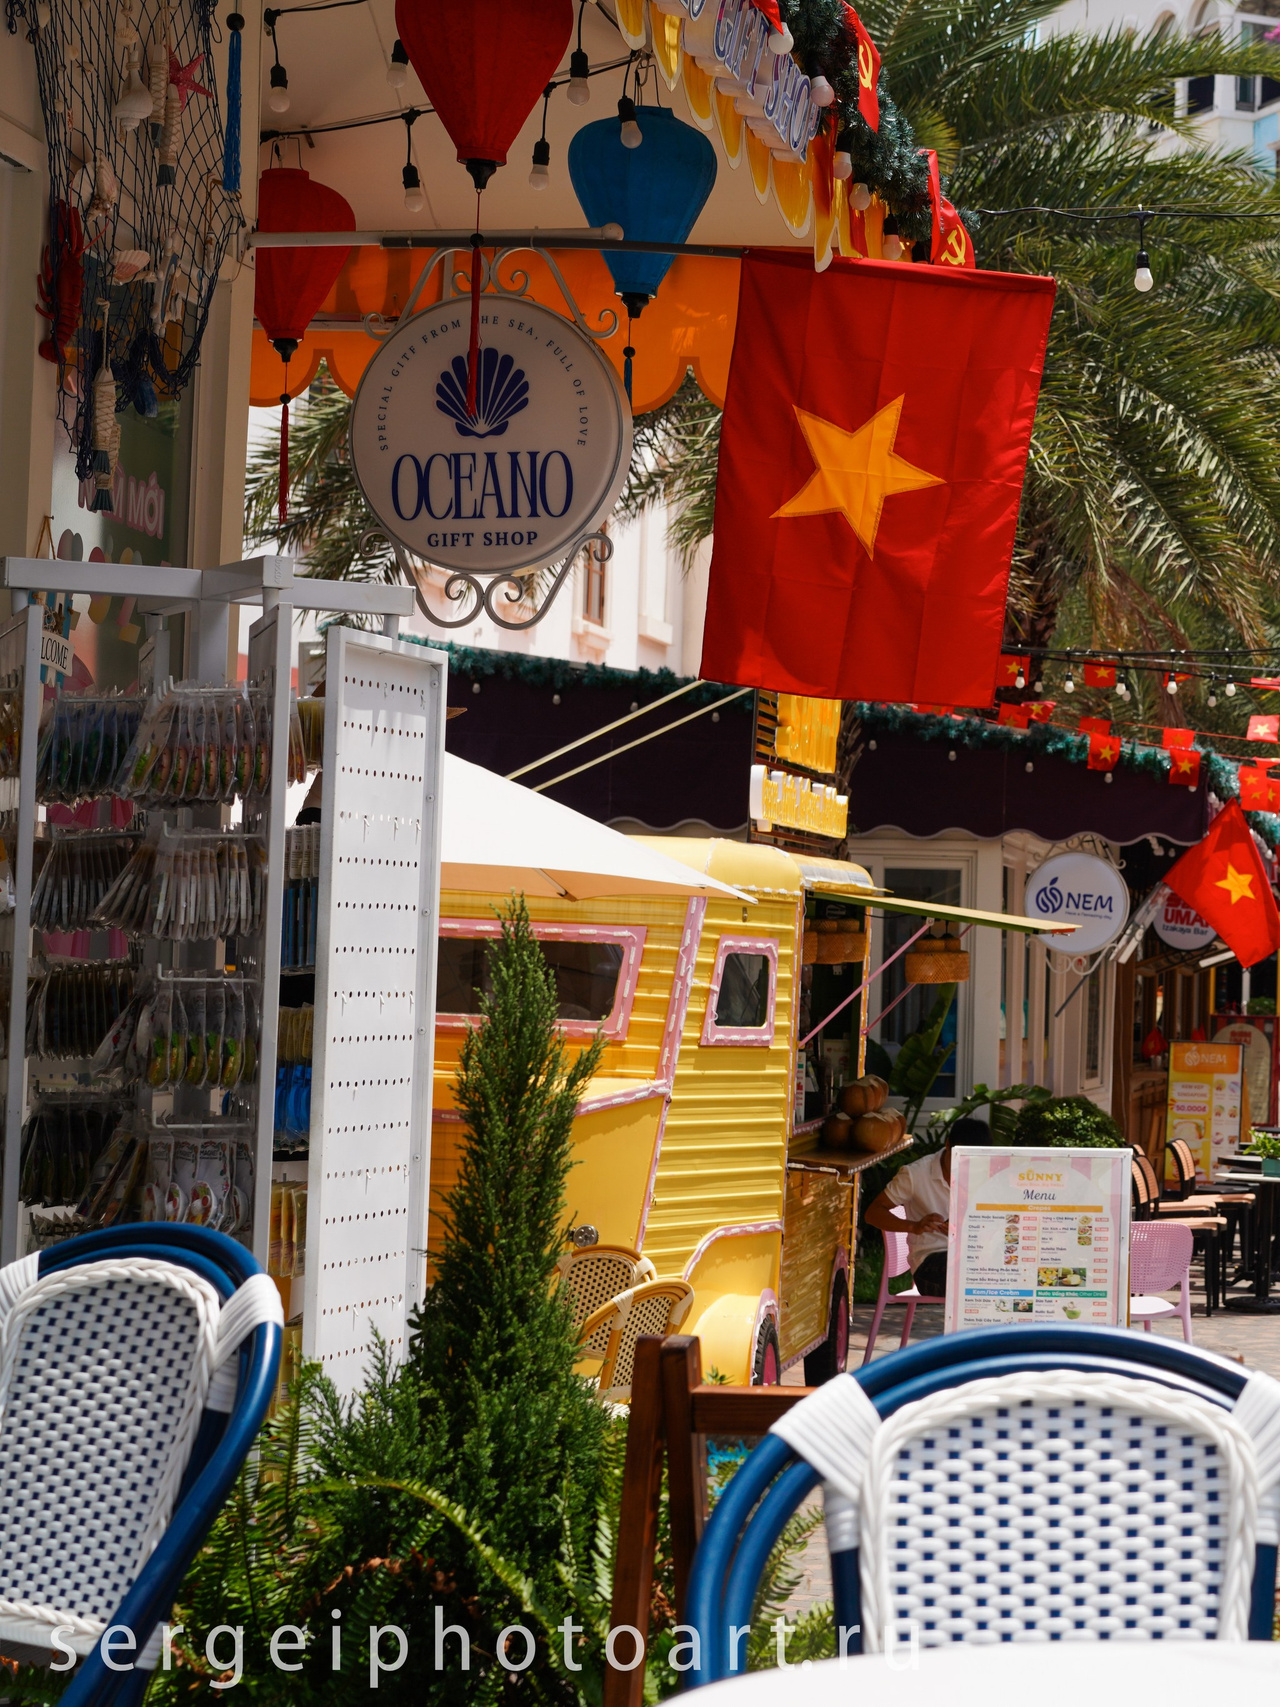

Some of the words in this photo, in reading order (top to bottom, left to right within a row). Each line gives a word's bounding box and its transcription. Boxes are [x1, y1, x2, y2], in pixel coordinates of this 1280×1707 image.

[421, 318, 463, 344] FROM
[508, 318, 540, 341] SEA,
[546, 339, 575, 373] FULL
[572, 378, 586, 397] OF
[376, 384, 393, 452] SPECIAL
[576, 405, 589, 447] LOVE
[391, 450, 574, 521] OCEANO
[427, 532, 475, 548] GIFT
[483, 530, 539, 547] SHOP
[41, 636, 69, 670] LCOME
[1066, 892, 1113, 913] NEM
[1200, 1053, 1227, 1064] NEM
[1023, 1188, 1057, 1201] Menu
